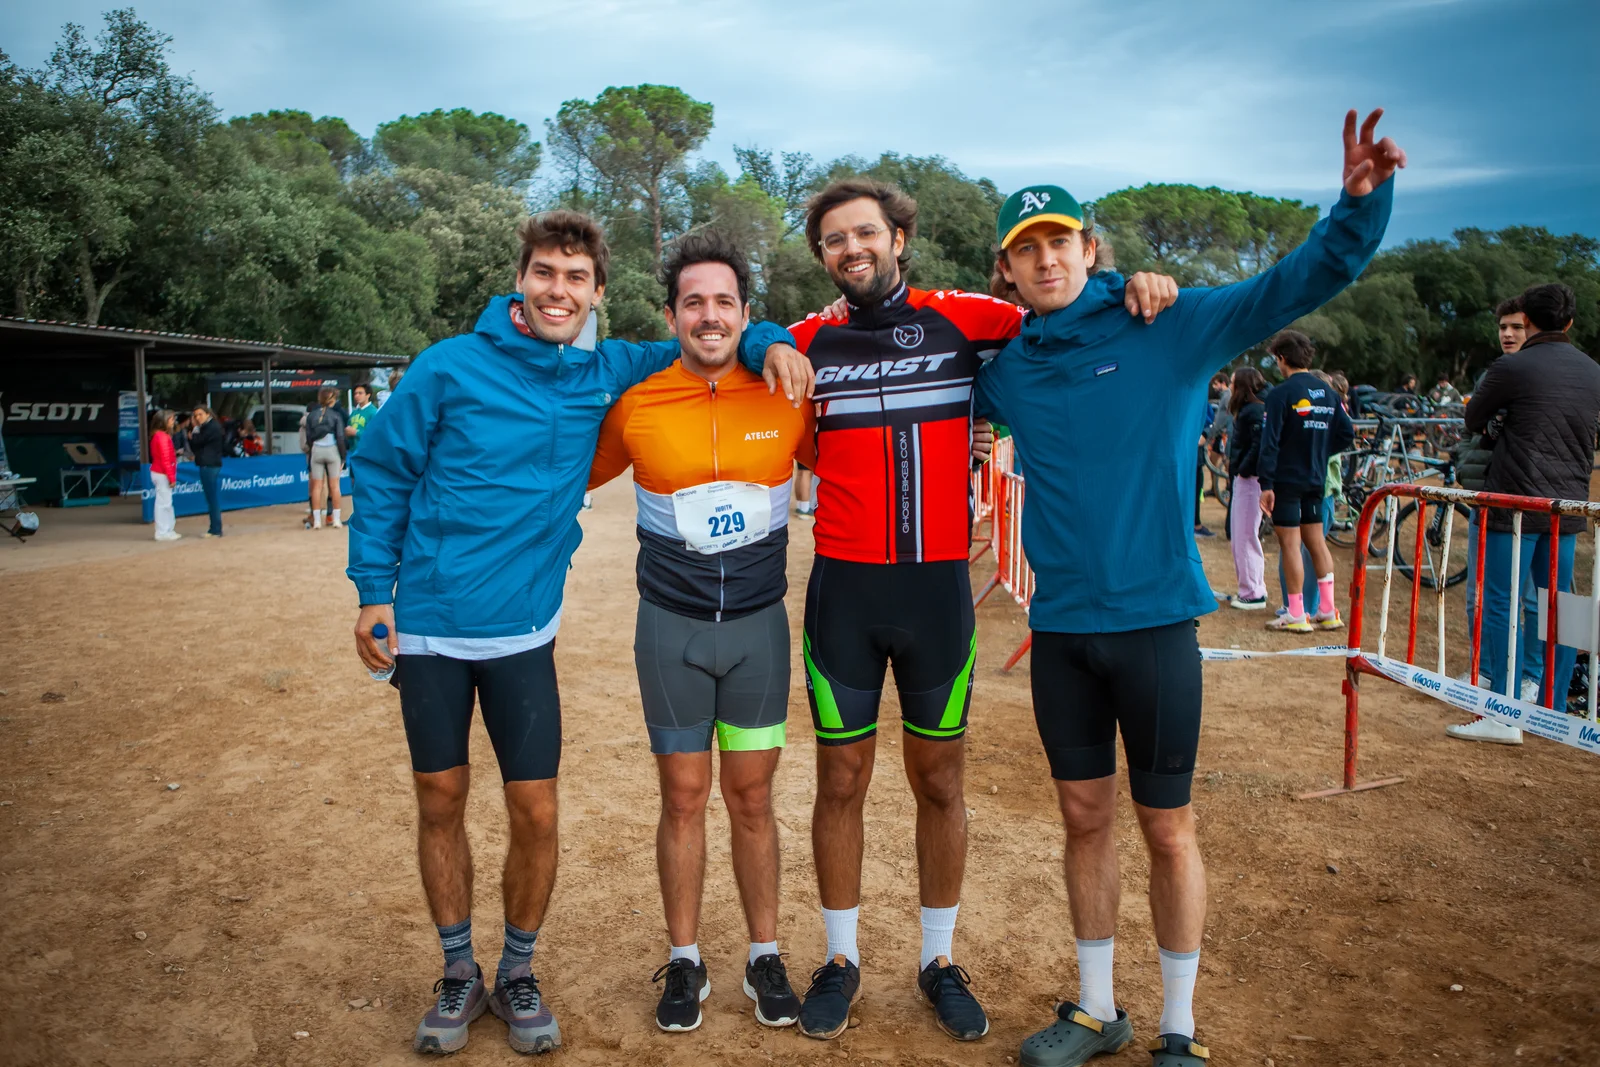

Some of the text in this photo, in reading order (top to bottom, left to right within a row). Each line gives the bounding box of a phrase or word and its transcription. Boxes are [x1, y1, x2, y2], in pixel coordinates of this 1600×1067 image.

[1018, 191, 1051, 218] A's
[815, 351, 958, 385] GHOST
[6, 402, 105, 421] SCOTT
[744, 429, 779, 441] ATELCIC
[253, 473, 295, 488] Foundation
[899, 431, 910, 534] GHOST-BIKES.COM
[707, 511, 746, 538] 229
